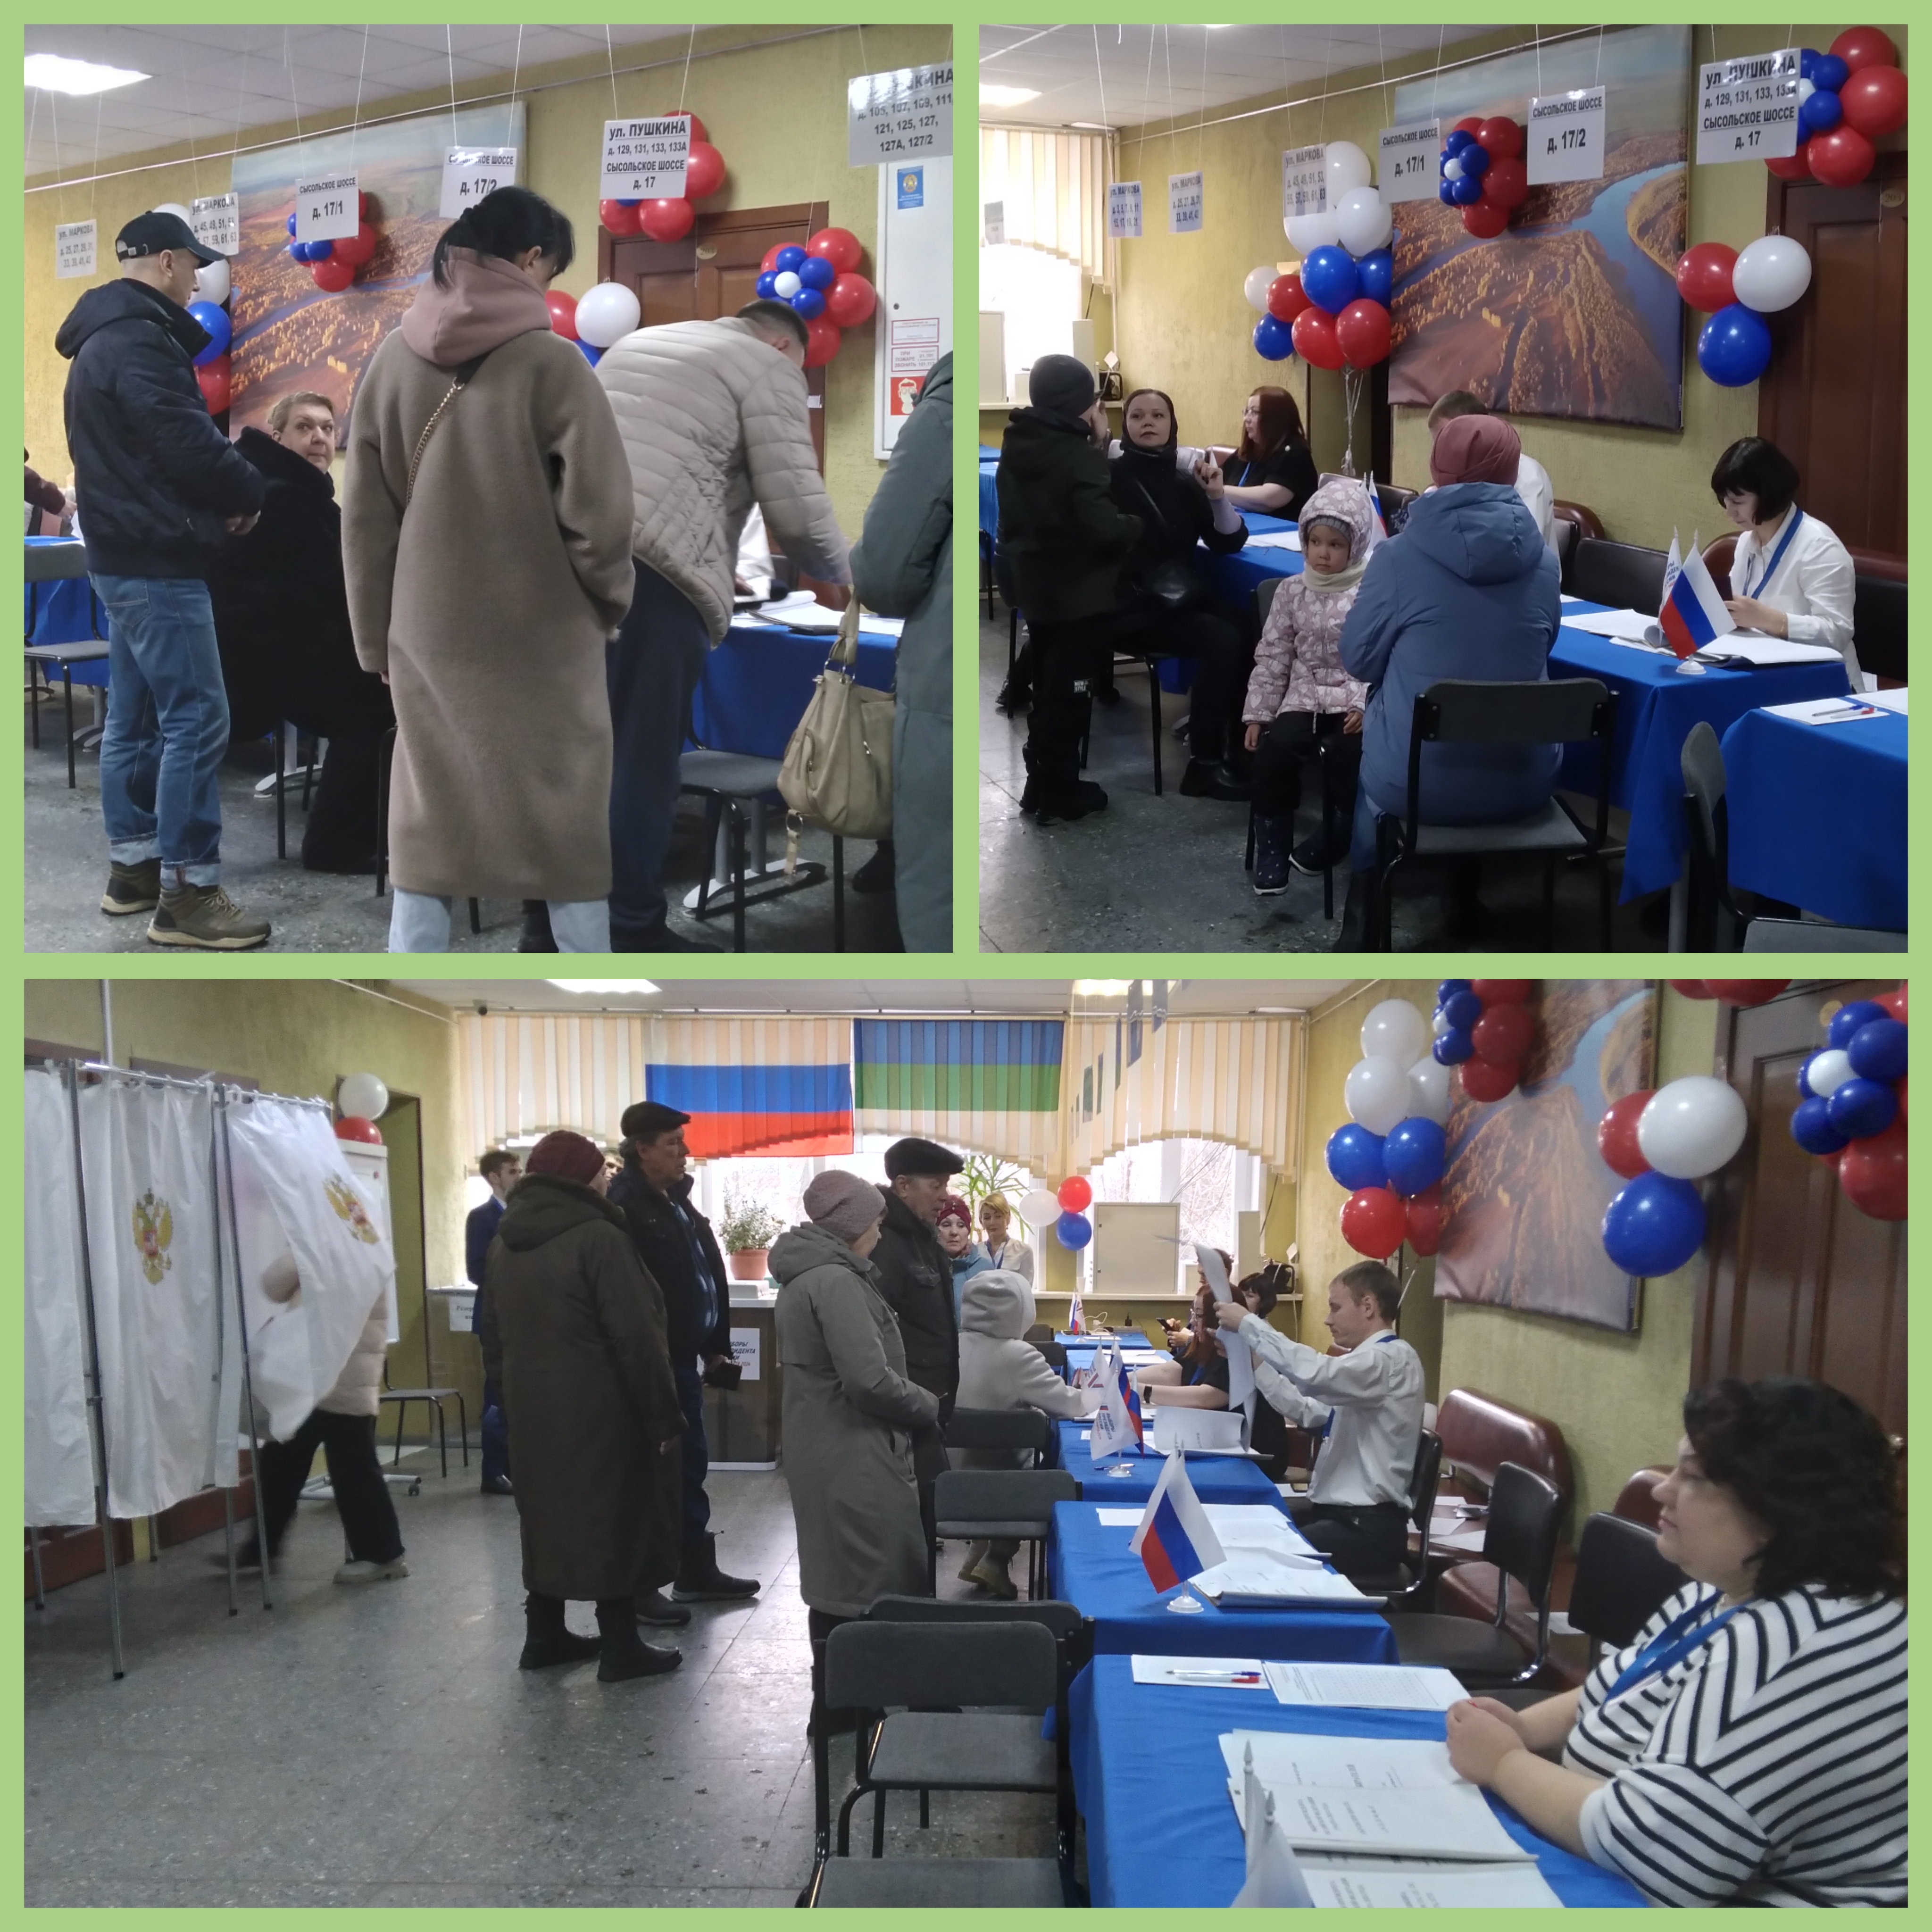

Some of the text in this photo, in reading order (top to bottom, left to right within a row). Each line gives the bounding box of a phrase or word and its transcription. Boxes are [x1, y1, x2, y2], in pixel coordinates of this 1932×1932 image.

[870, 106, 888, 117] 105,
[891, 102, 910, 113] 107,
[914, 97, 933, 109] 109,
[1533, 96, 1602, 117] СЫСОЛЬСКОЕ ШОССЕ
[1705, 98, 1712, 109] д.
[1716, 92, 1732, 106] 129,
[1735, 90, 1752, 104] 131,
[1755, 87, 1773, 100] 133,
[874, 115, 938, 134] 121, 125, 127,
[1704, 106, 1795, 129] СЫСОЛЬСКОЕ ШОССЕ
[609, 121, 686, 141] ул. ПУШКИНА
[1383, 127, 1438, 146] СЫСОЛЬСКОЕ ШОССЕ
[1735, 131, 1761, 150] д. 17
[608, 142, 686, 156] д. 129, 131, 133, 133А
[880, 134, 933, 152] 127А, 127/2
[1547, 128, 1586, 155] д. 17/2
[491, 156, 513, 165] ШОССЕ
[607, 159, 684, 172] СЫСОЛЬСКОЕ ШОССЕ
[1286, 148, 1324, 168] ул. МАРКОВА
[1395, 155, 1424, 177] д. 17/1
[300, 177, 356, 194] СЫСОЛЬСКОЕ ШОССЕ
[460, 178, 497, 196] д. 17/2
[633, 176, 655, 190] д. 17
[313, 200, 342, 221] д. 17/1
[218, 218, 226, 230] 51,
[221, 233, 229, 245] 61,
